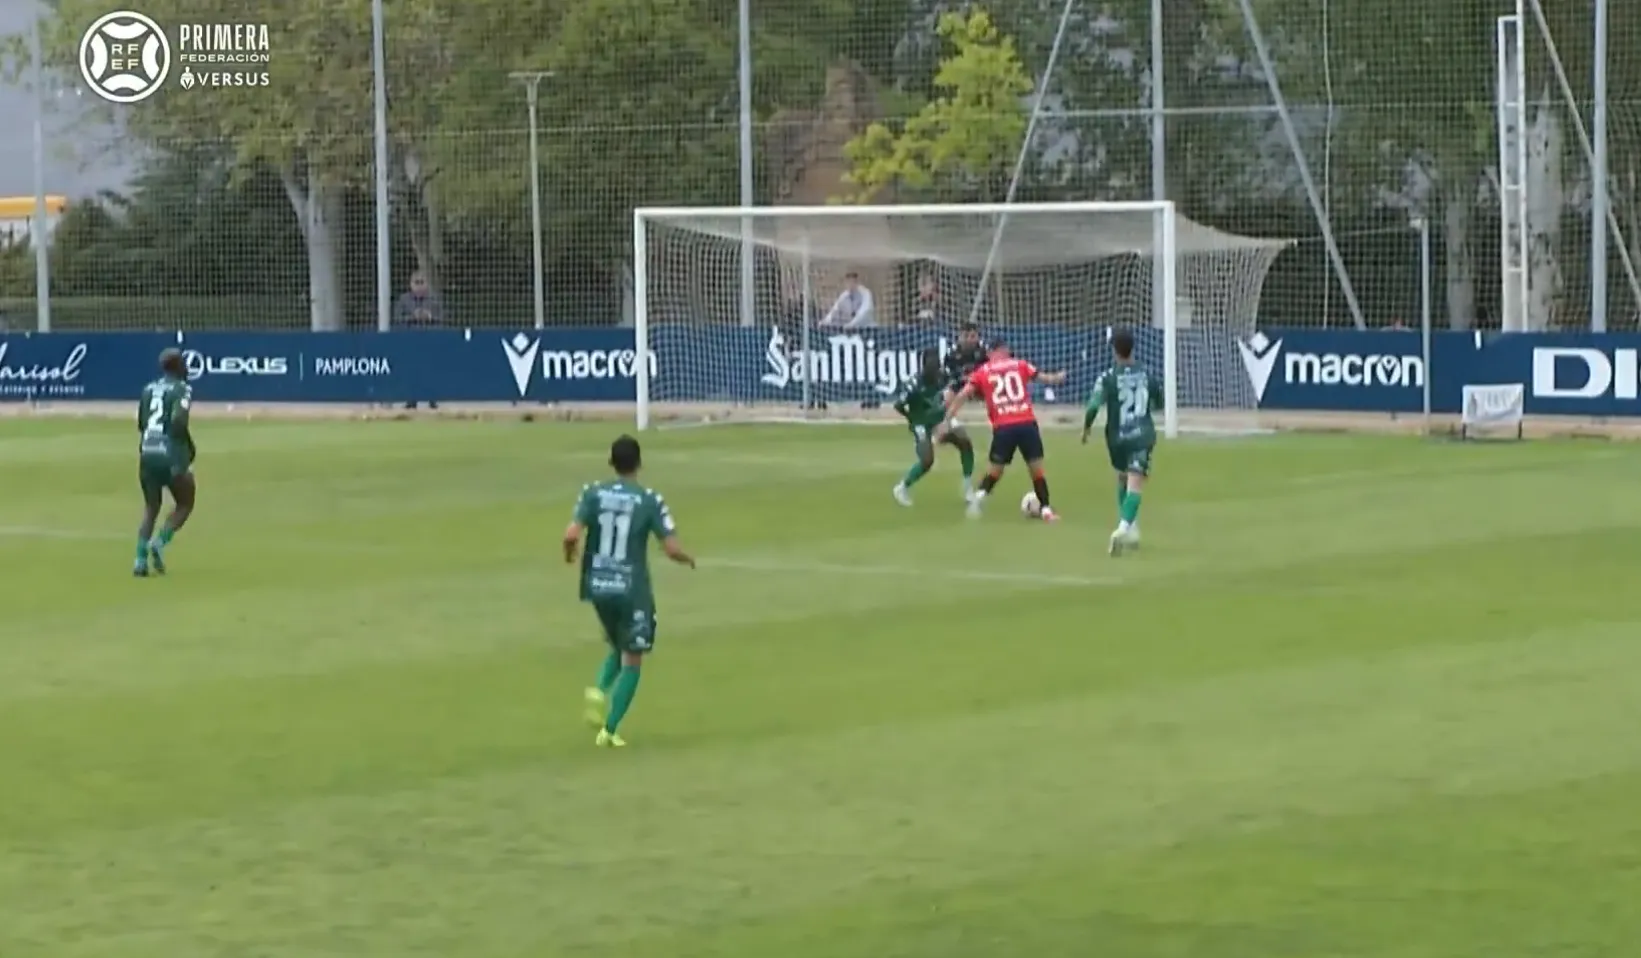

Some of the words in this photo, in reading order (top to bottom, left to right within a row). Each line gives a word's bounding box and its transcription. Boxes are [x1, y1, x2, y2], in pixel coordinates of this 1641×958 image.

[206, 356, 287, 374] LEXUS
[315, 357, 390, 375] PAMPLONA
[1285, 352, 1424, 386] macron
[988, 371, 1025, 404] 20
[149, 398, 164, 431] 2
[598, 511, 631, 561] 11
